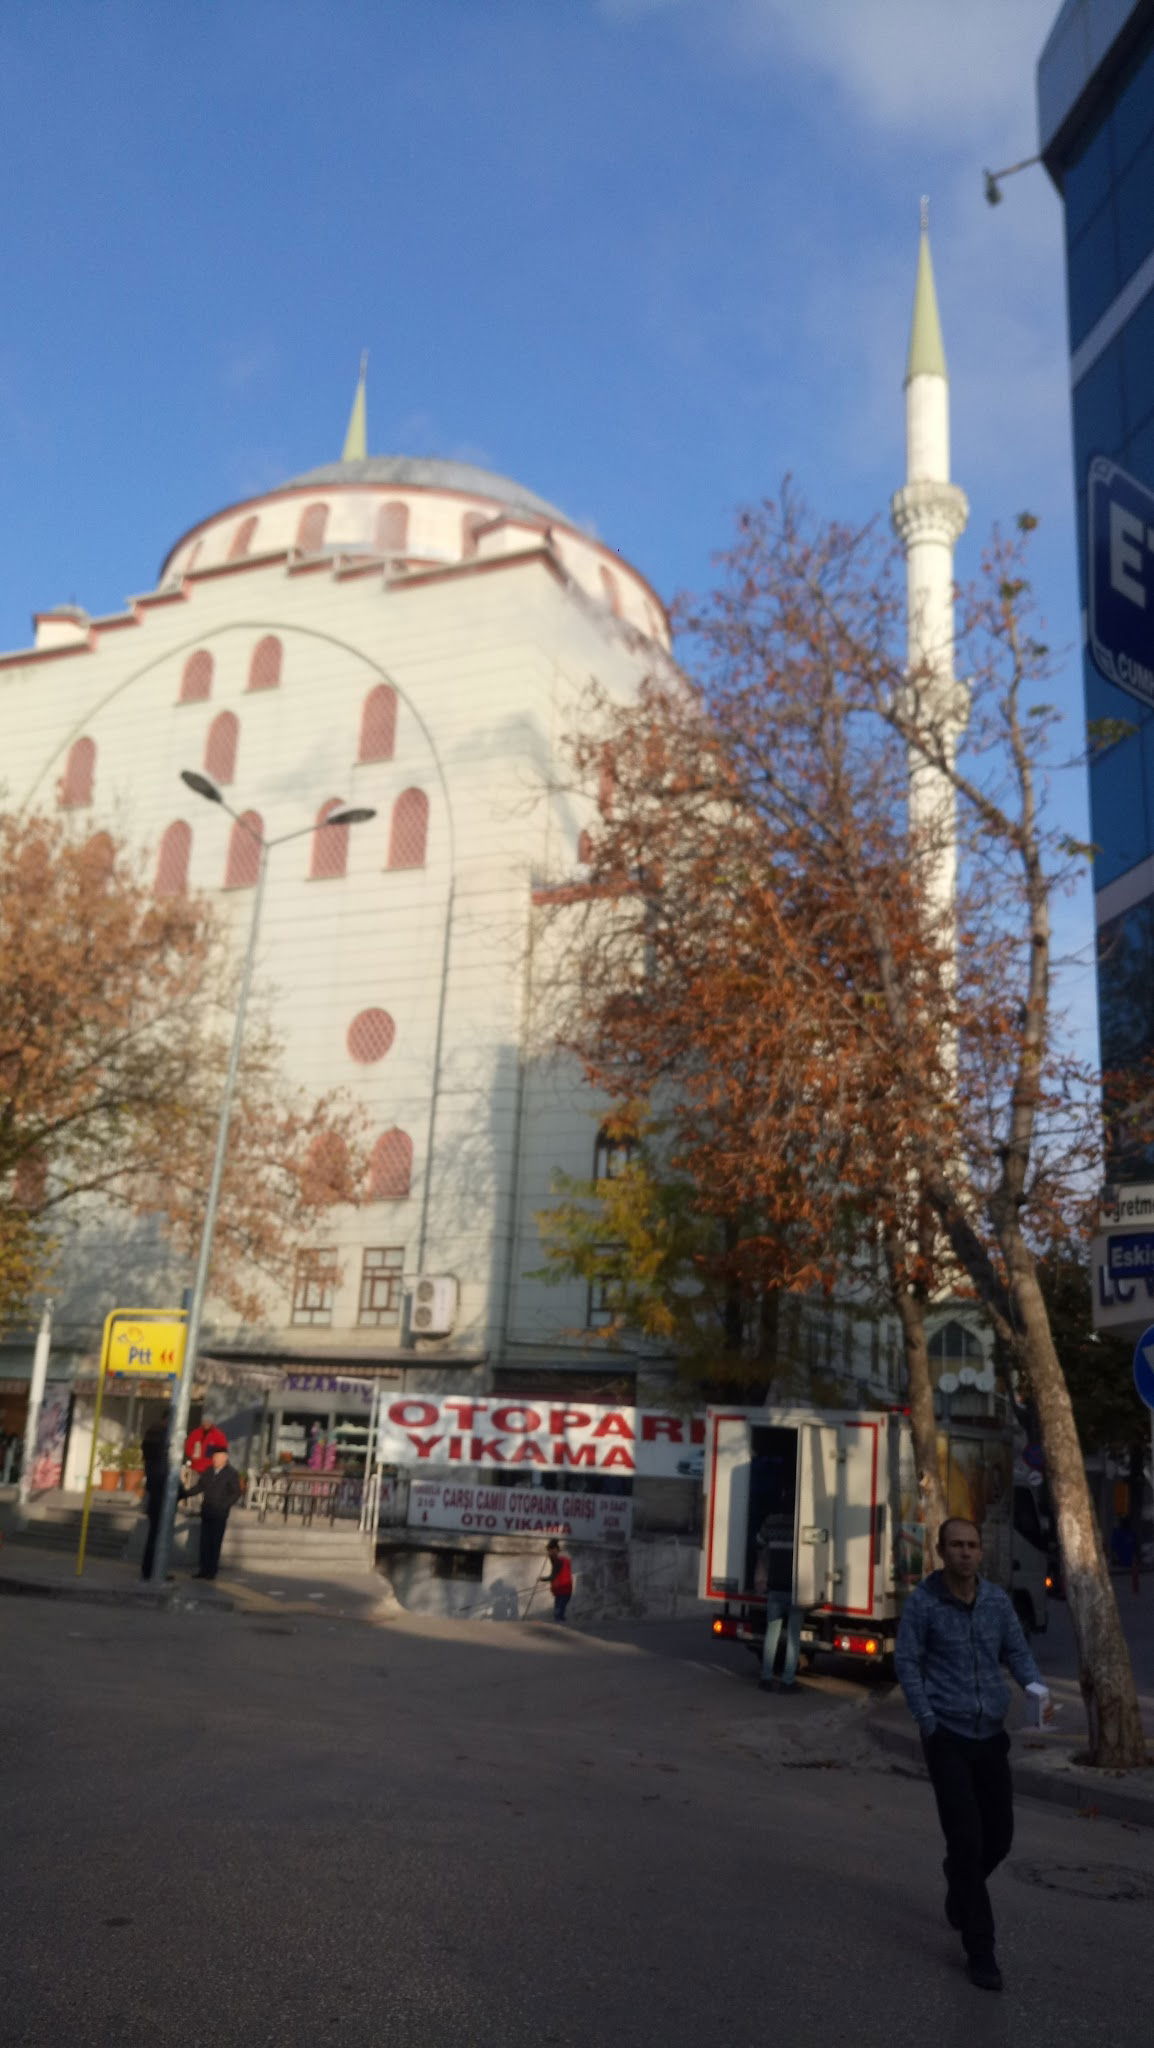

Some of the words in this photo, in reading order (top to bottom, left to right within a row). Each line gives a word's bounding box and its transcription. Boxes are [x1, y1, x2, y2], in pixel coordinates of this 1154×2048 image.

[1111, 1244, 1154, 1268] Eski
[128, 1345, 152, 1365] Ptt
[406, 1433, 636, 1469] YIKAMA
[442, 1487, 474, 1511] ÇARŞI
[509, 1492, 558, 1517] OTOPARK
[461, 1512, 497, 1529] OTO
[503, 1516, 572, 1535] YIKAMA
